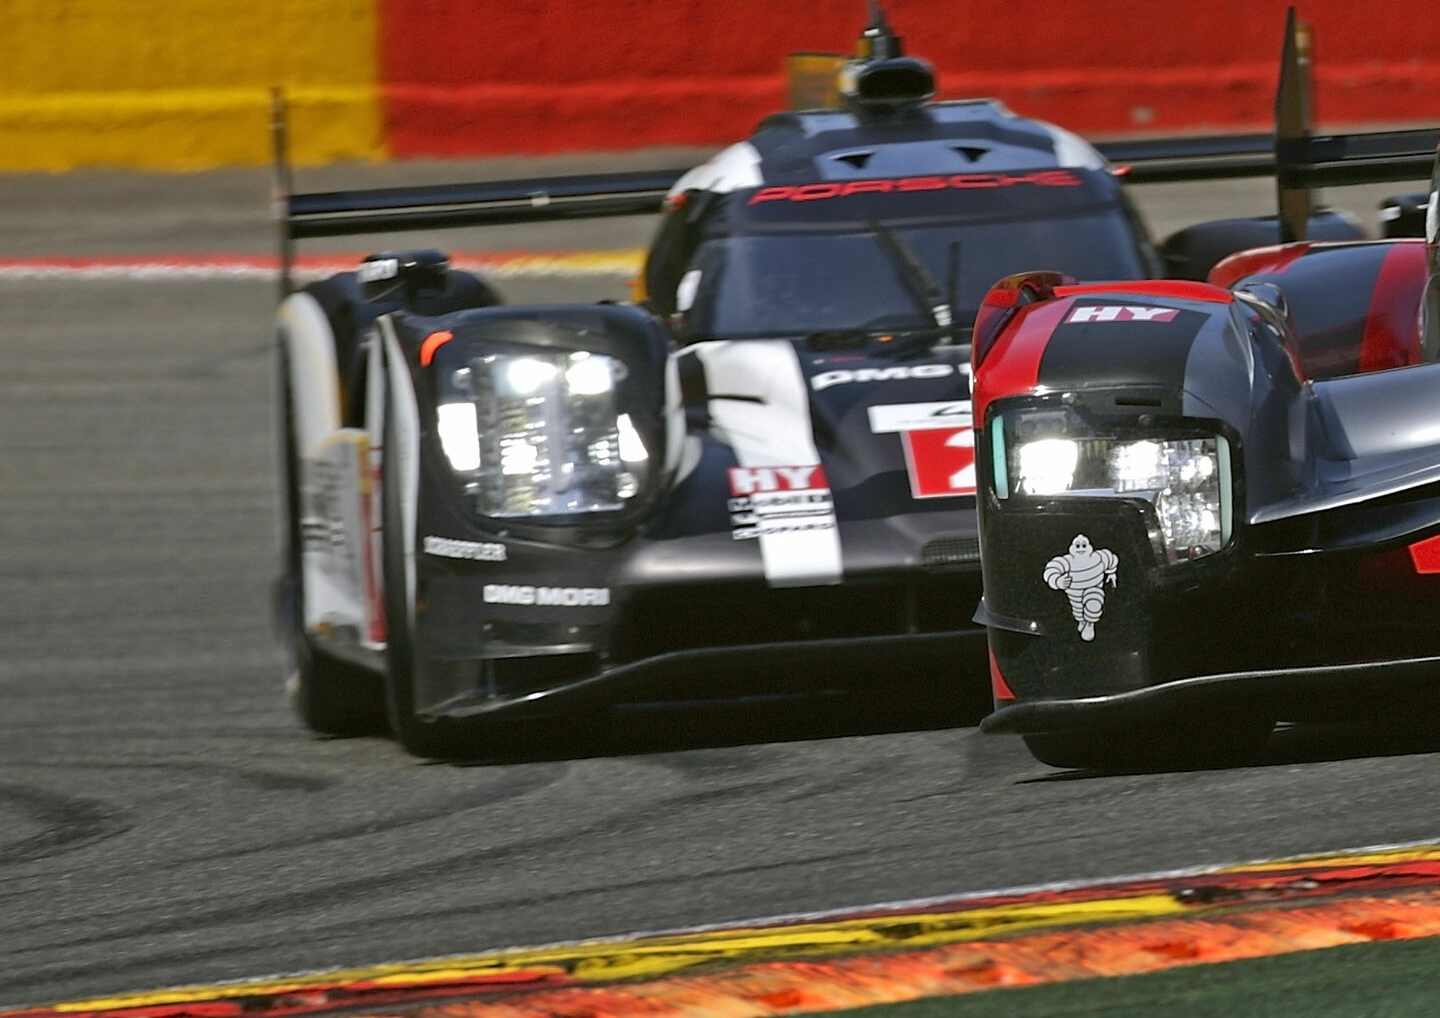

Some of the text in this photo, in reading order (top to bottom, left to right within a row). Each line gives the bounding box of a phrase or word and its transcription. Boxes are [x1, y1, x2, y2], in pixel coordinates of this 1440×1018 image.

[748, 170, 1082, 205] PORSCHE
[1069, 305, 1176, 323] HY
[811, 364, 953, 391] DMG
[731, 466, 818, 495] HY
[483, 584, 610, 607] DMG MORI
